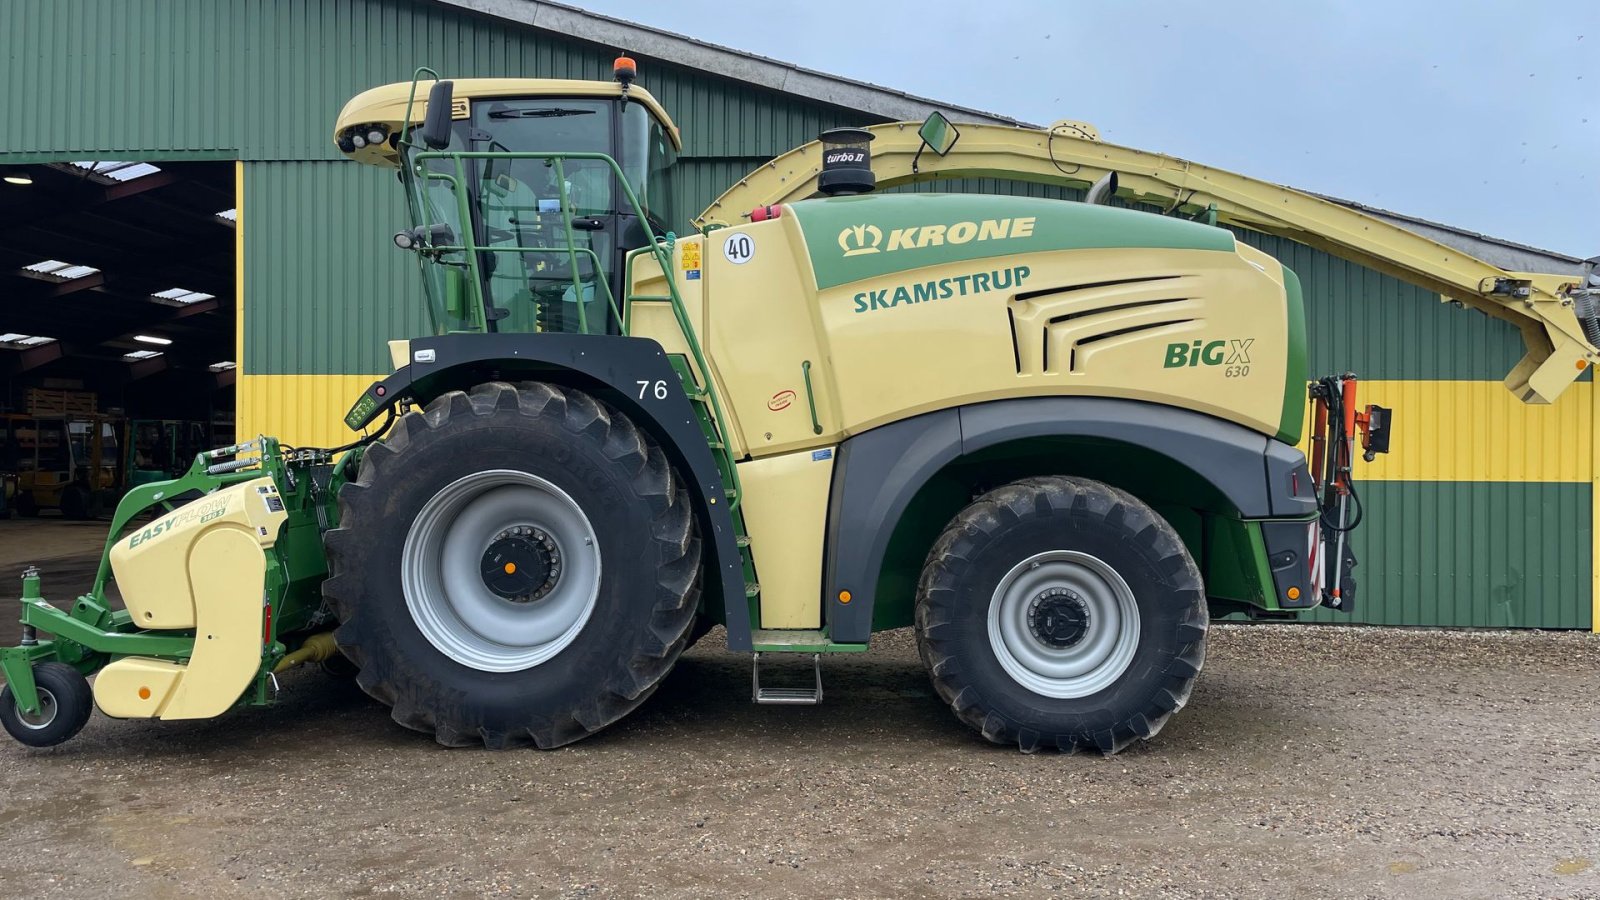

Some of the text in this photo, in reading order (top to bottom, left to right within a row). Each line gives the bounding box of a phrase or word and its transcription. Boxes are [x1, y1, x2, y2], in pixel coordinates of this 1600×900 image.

[886, 216, 1036, 251] KRONE
[728, 237, 750, 259] 40
[853, 265, 1031, 313] SKAMSTRUP
[1225, 365, 1250, 378] 630
